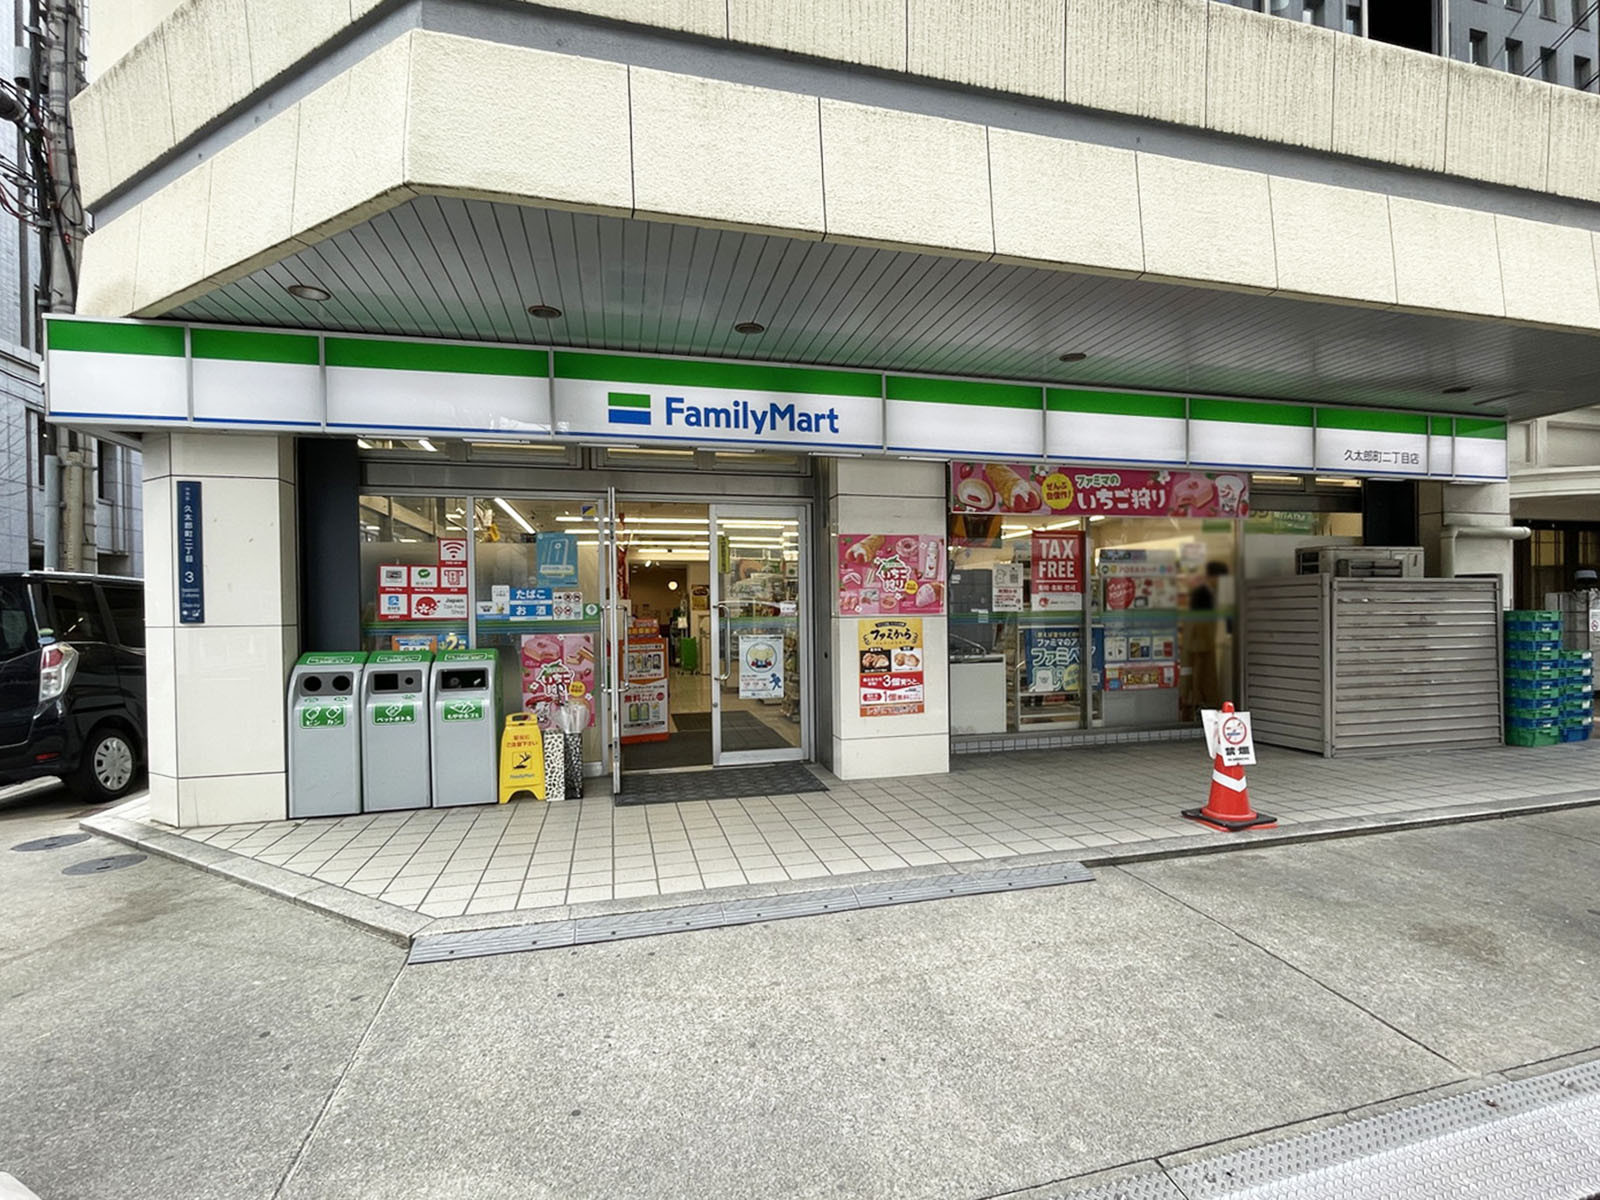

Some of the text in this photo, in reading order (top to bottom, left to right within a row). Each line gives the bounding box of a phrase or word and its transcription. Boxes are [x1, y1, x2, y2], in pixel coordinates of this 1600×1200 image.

[665, 396, 840, 435] FamilyMart
[1344, 449, 1420, 465] 久太郎町二丁目店
[1075, 474, 1120, 488] ファミマの
[1077, 488, 1166, 510] いちご狩り
[184, 505, 194, 563] 久太郎町二丁目
[1039, 539, 1075, 559] TAX
[184, 571, 195, 583] 3
[1039, 560, 1075, 578] FREE
[516, 589, 546, 600] たばこ
[870, 628, 912, 641] ファミから
